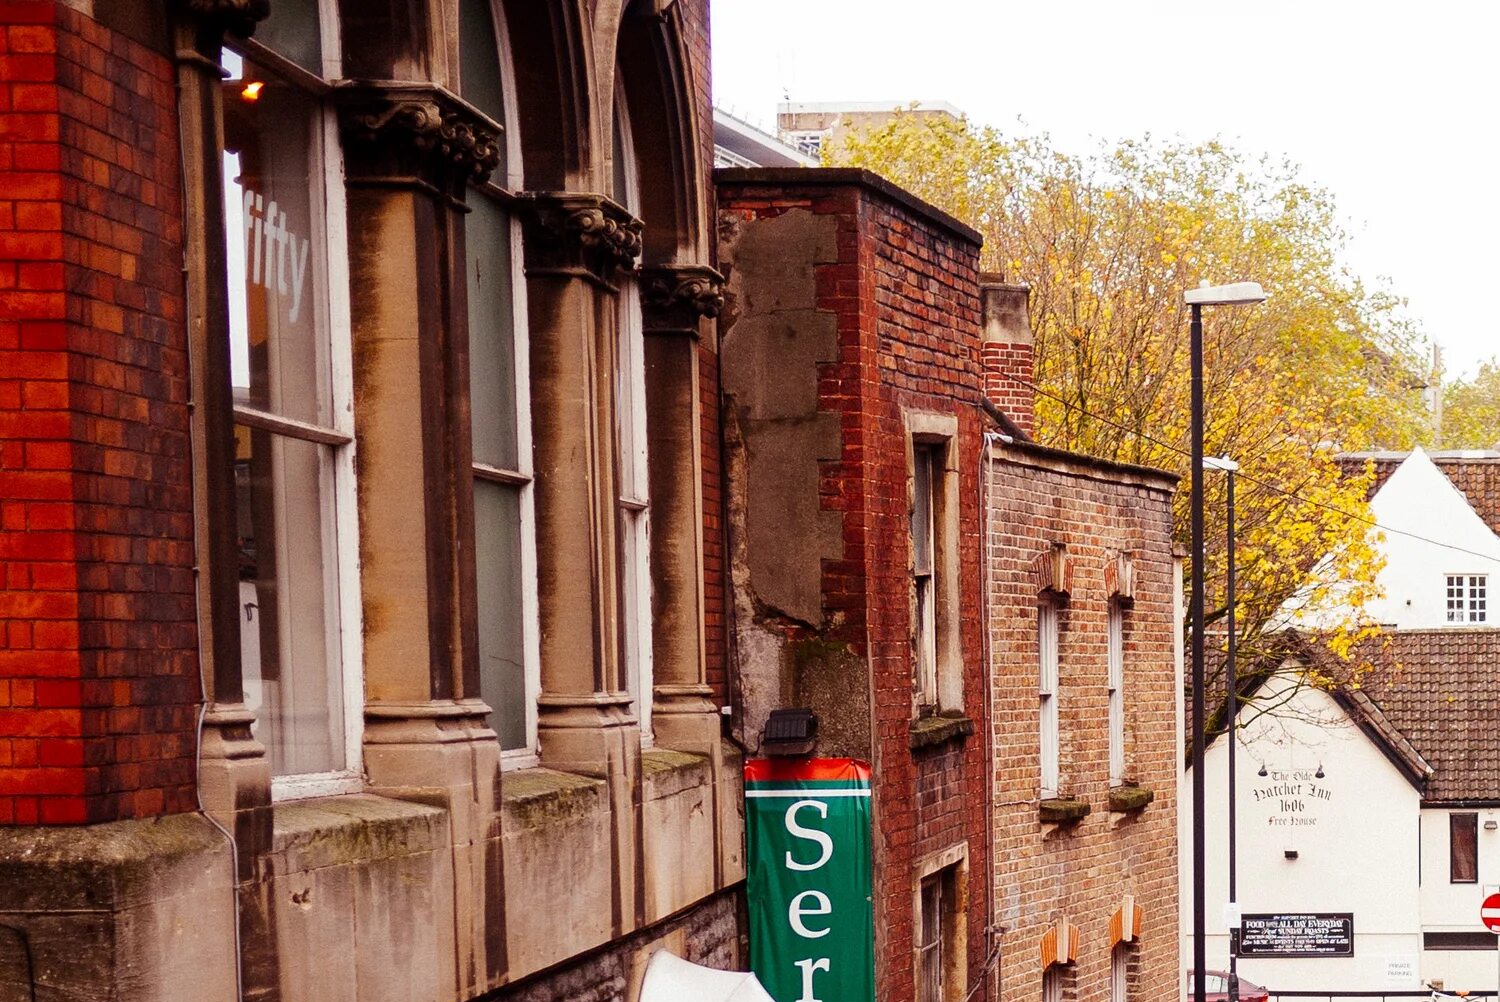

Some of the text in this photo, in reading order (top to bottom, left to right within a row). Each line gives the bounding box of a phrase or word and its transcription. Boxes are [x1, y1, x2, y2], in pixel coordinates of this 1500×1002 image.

[243, 189, 310, 324] fifty
[1271, 771, 1313, 781] The Olde
[1253, 782, 1332, 802] Hatchet Inn
[1280, 799, 1305, 812] 1606
[1268, 816, 1317, 826] Free House
[1278, 920, 1293, 928] ALL
[1294, 920, 1307, 928] DAY
[1308, 920, 1344, 928] EVERYDAY
